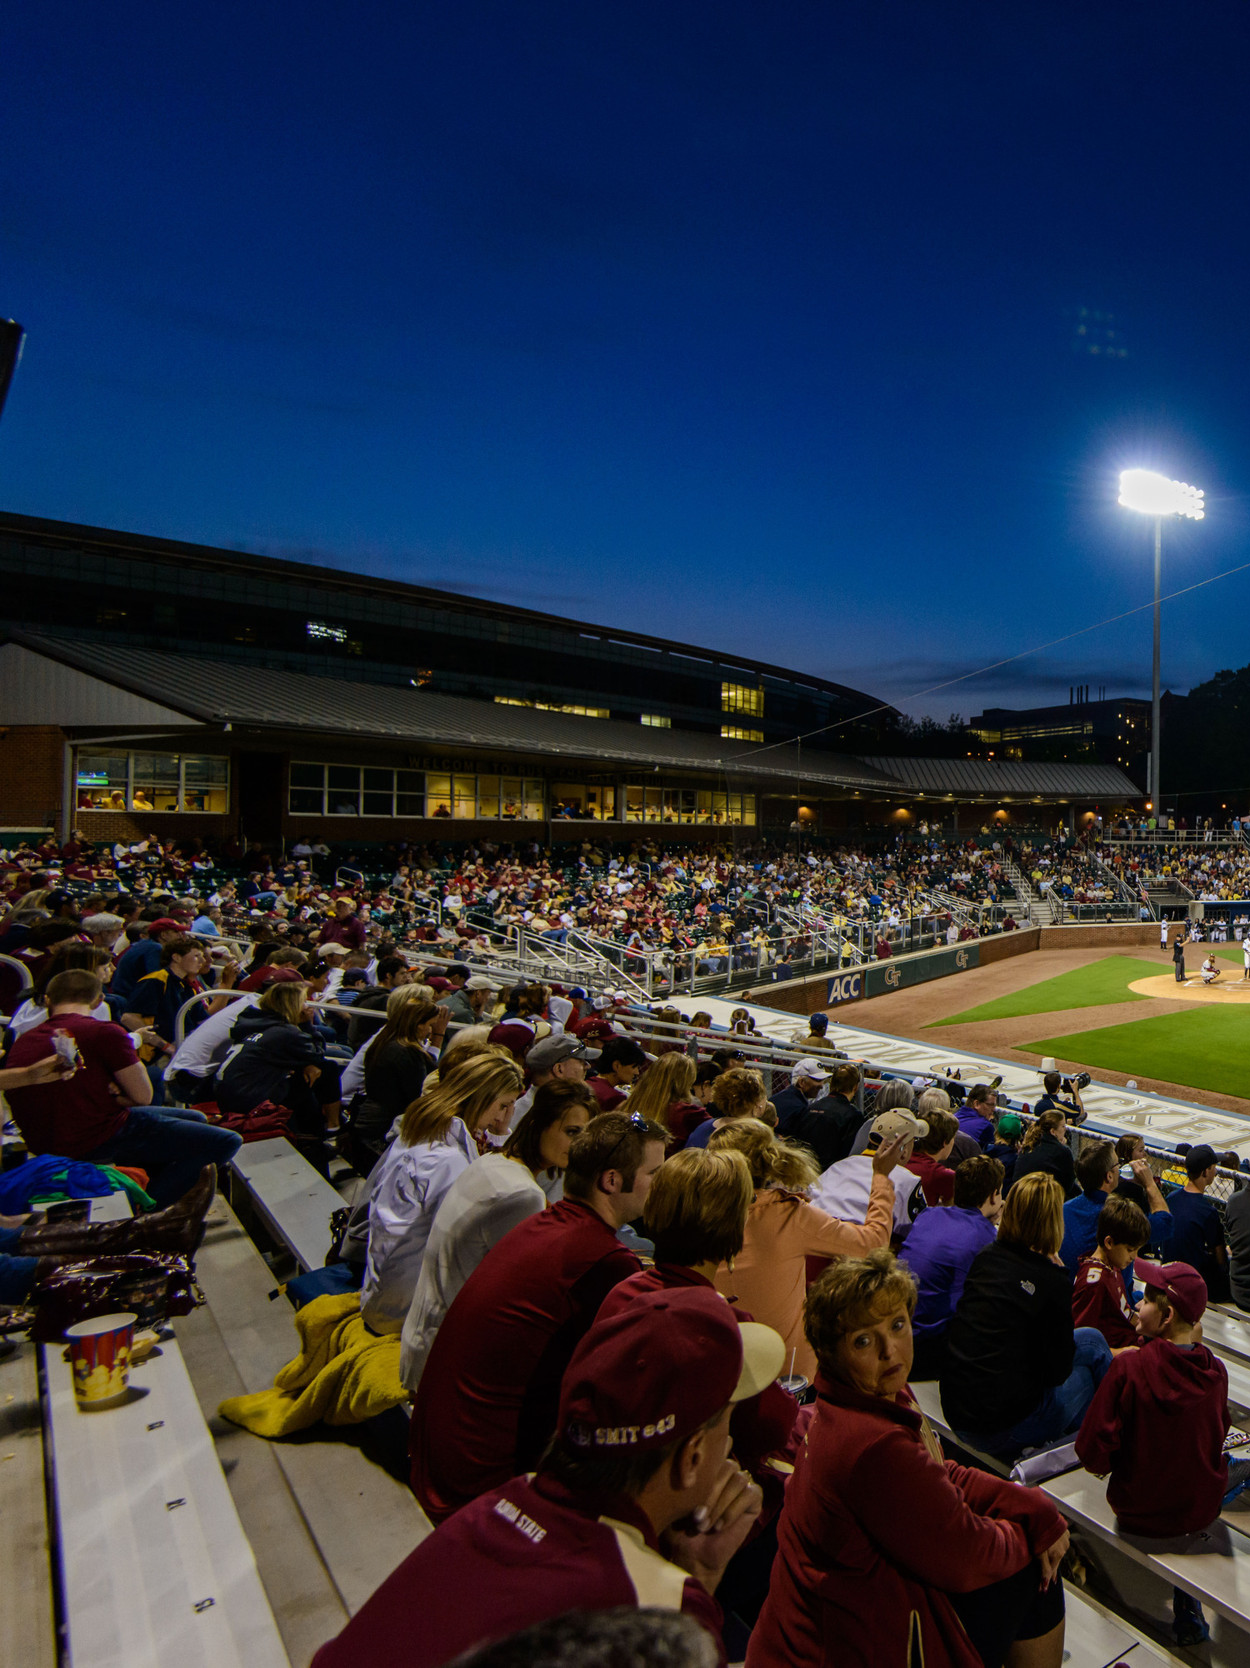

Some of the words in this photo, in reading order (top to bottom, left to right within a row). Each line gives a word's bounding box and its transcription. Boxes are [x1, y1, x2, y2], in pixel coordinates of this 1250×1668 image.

[407, 754, 482, 773] WELCOME
[492, 762, 511, 775] TO
[828, 973, 861, 1004] ACC
[1086, 1267, 1103, 1284] 5
[515, 1514, 547, 1543] STATE
